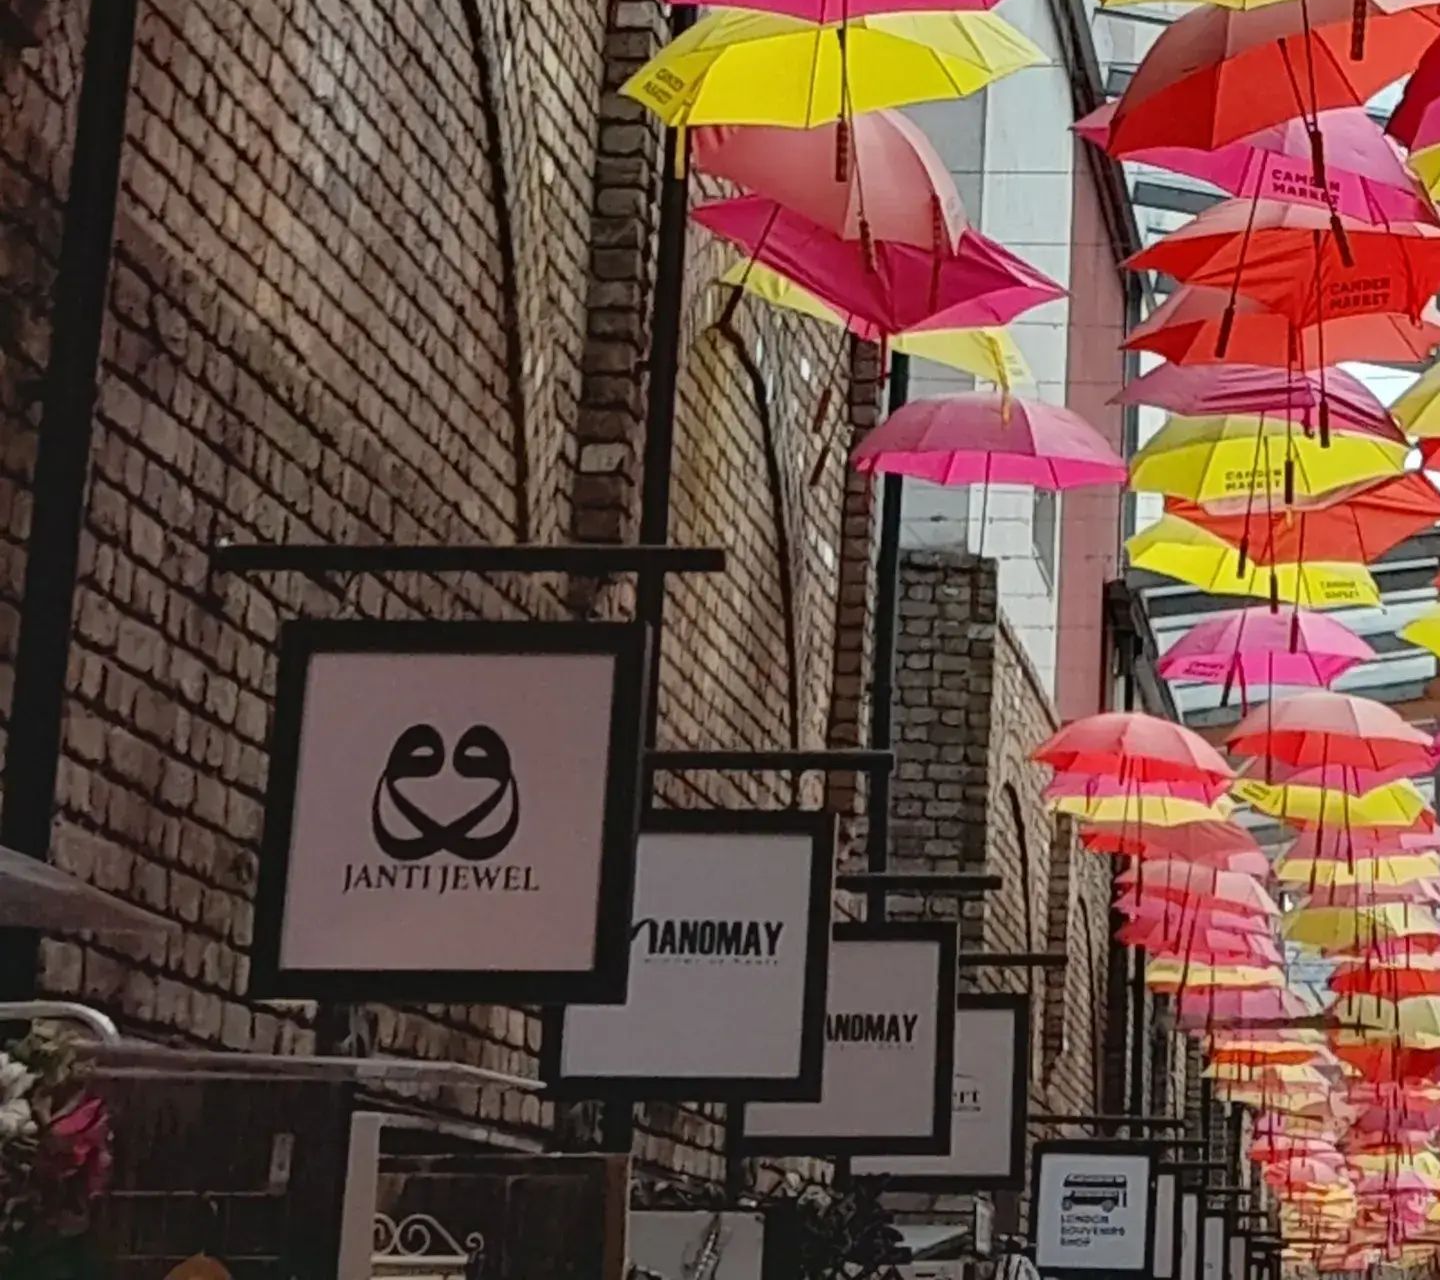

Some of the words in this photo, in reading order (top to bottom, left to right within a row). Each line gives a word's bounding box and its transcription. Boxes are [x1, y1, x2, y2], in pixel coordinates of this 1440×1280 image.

[1271, 168, 1340, 193] CAMDN
[1272, 182, 1340, 205] MARKET
[1329, 277, 1391, 296] CAMDEN
[1329, 292, 1391, 311] MARKET
[343, 863, 430, 895] JANTI
[438, 865, 541, 895] JEWEL
